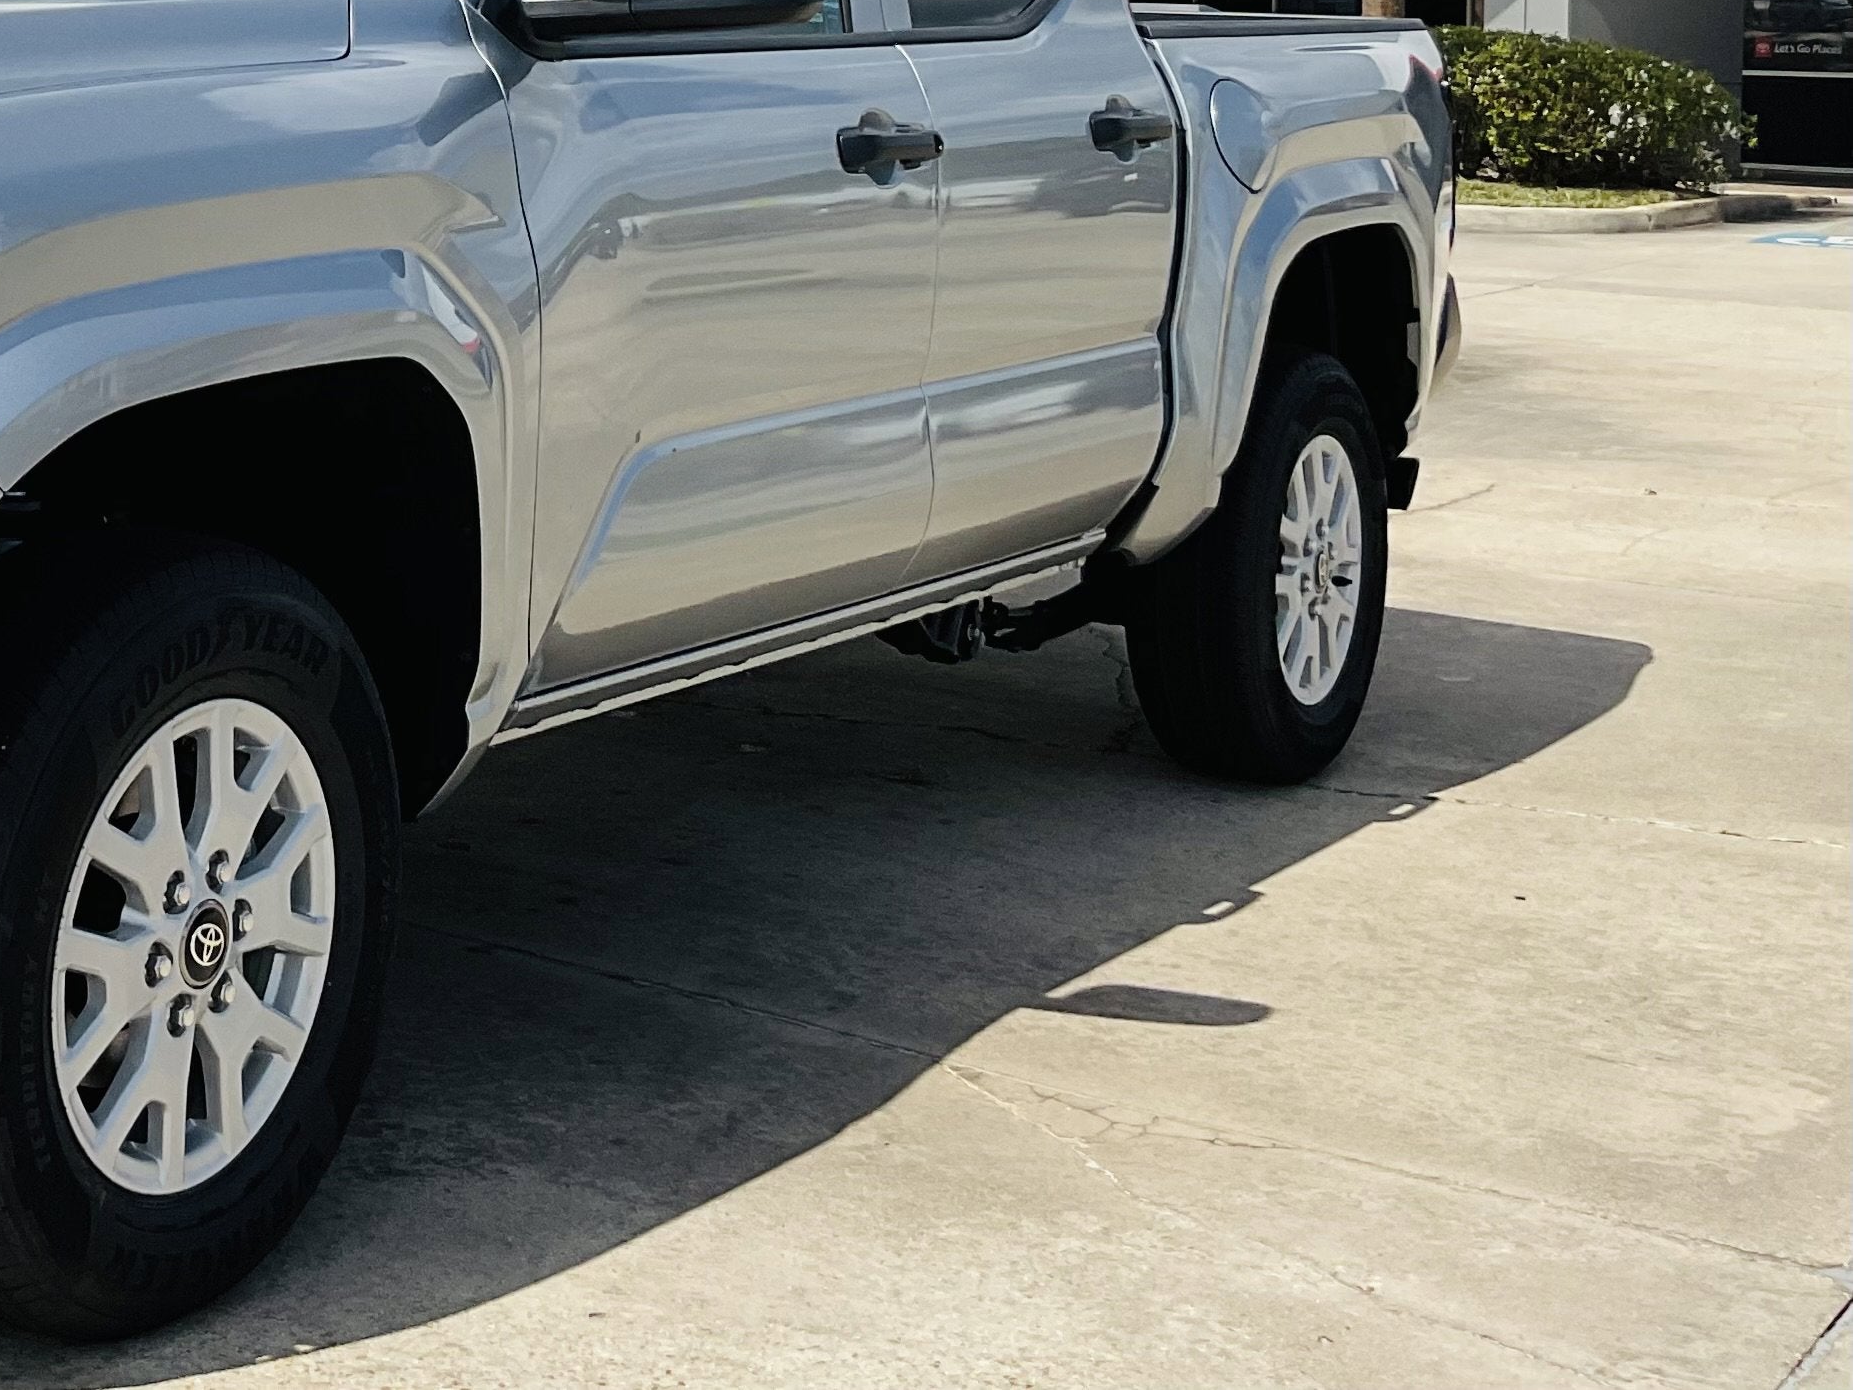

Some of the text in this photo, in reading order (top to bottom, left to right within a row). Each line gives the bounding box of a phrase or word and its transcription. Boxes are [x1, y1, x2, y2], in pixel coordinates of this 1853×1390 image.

[1773, 42, 1795, 54] Let's
[1796, 43, 1811, 54] Go
[109, 609, 329, 739] GOODYEAR
